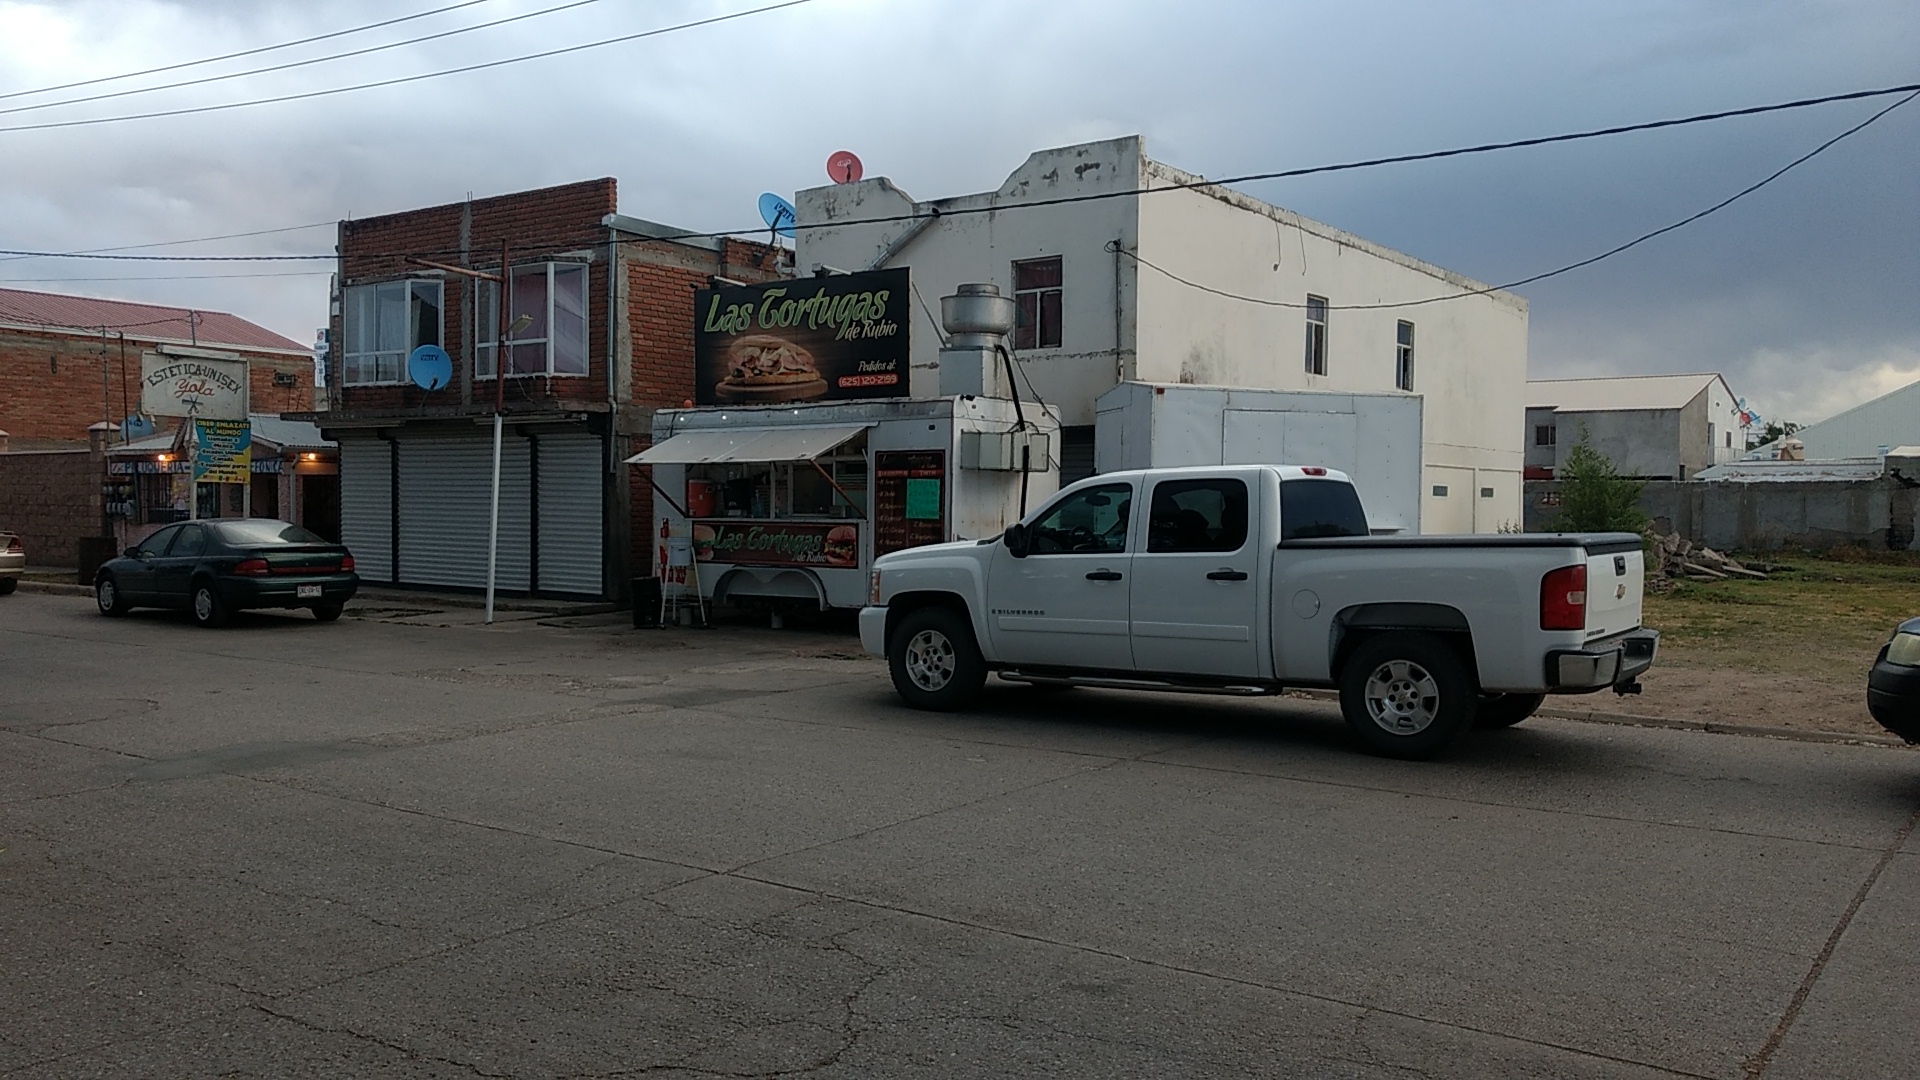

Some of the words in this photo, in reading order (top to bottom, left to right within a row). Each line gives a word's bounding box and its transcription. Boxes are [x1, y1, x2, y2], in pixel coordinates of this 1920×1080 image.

[704, 294, 754, 335] Las
[758, 287, 890, 341] Tortugas
[844, 321, 860, 341] de
[861, 319, 898, 340] Rubio
[858, 360, 886, 372] Pedidos
[838, 376, 860, 388] (625)
[861, 374, 897, 385] 120-2199
[125, 461, 184, 473] PUQUERIA
[713, 525, 743, 552] Las
[746, 526, 823, 561] Tortugas
[796, 551, 807, 562] de
[806, 550, 827, 563] Rubio
